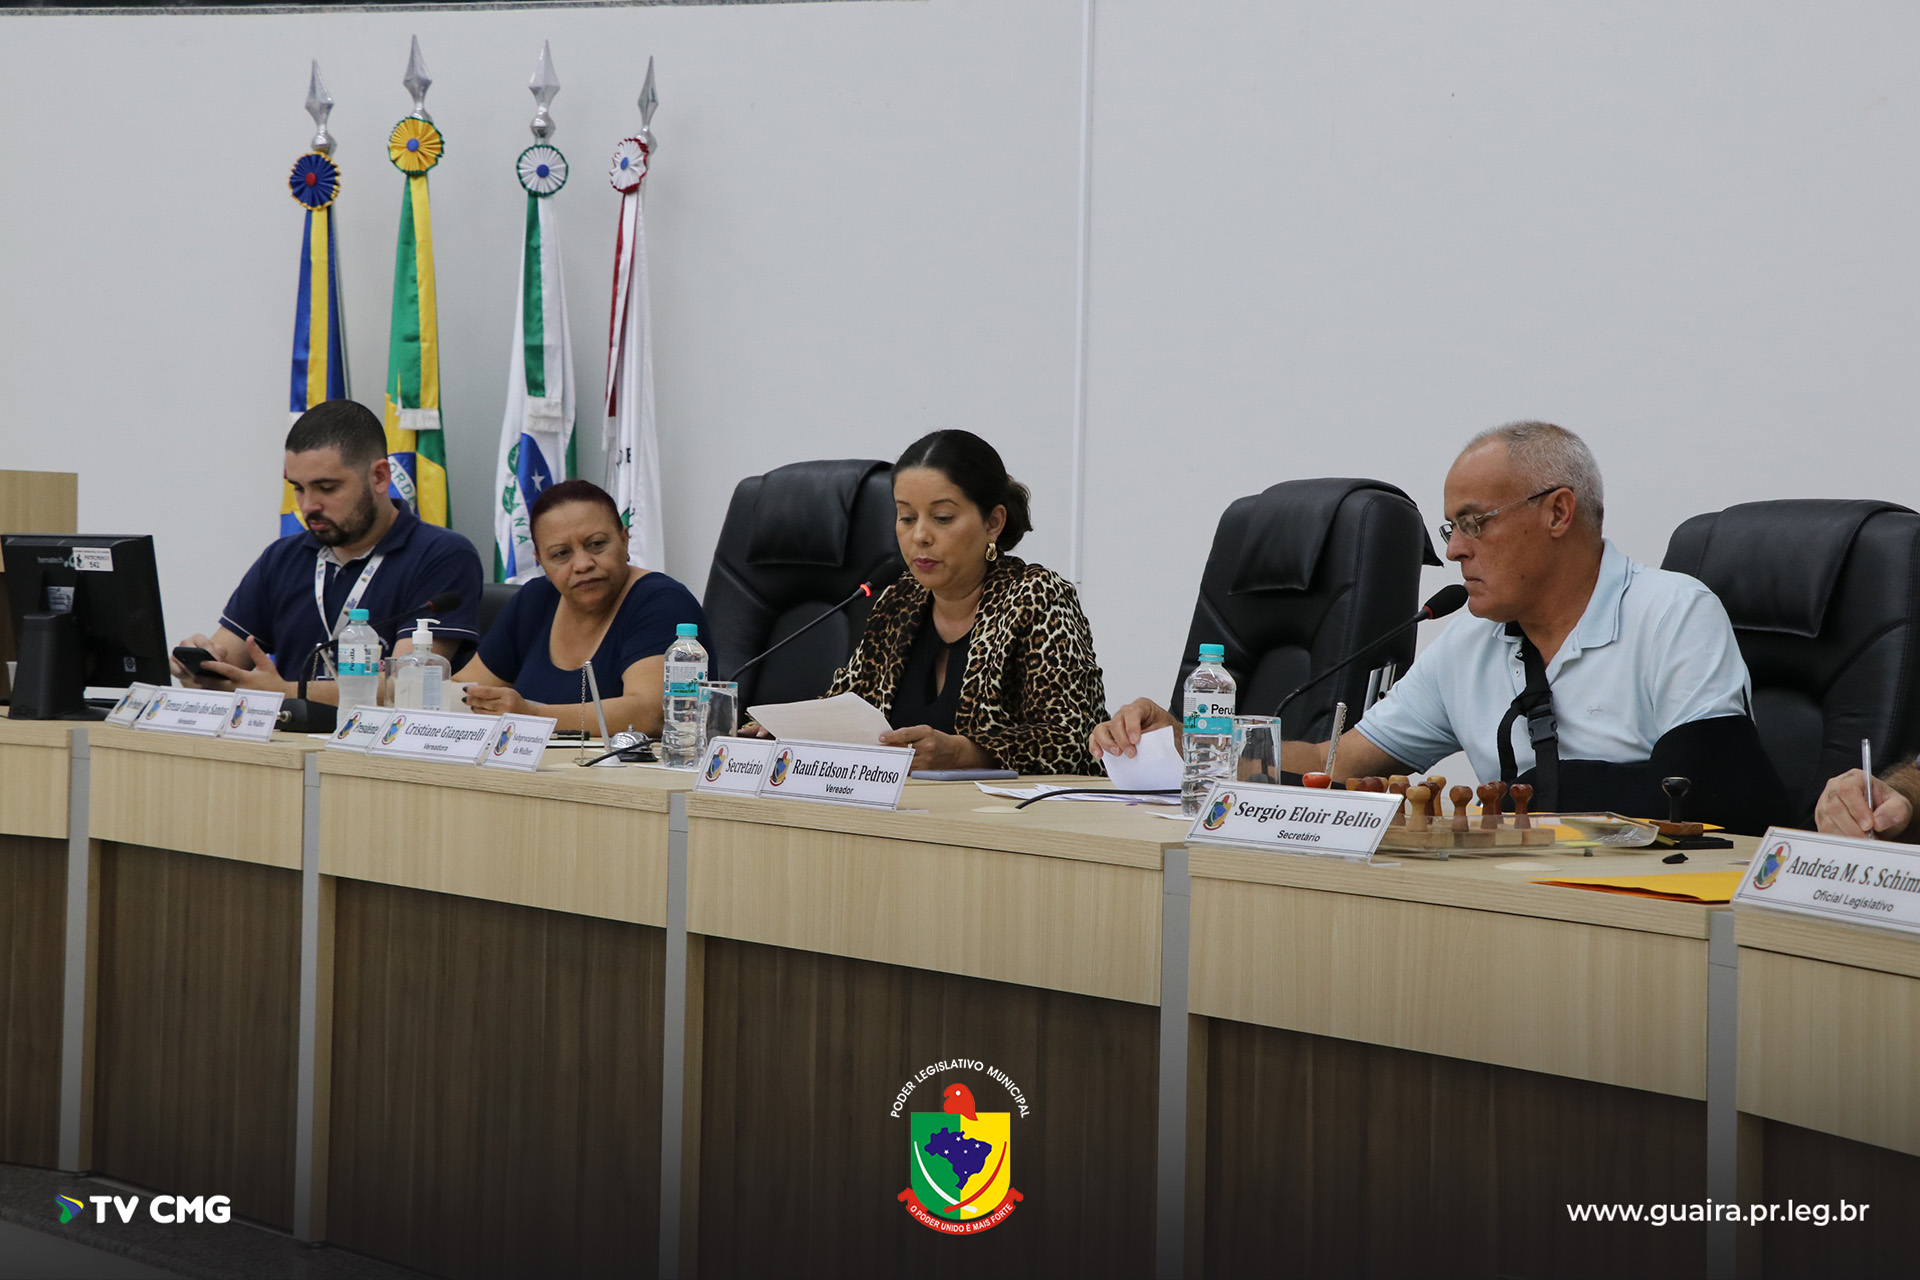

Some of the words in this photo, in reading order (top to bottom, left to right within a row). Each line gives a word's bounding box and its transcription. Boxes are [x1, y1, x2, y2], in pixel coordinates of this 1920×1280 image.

[405, 722, 441, 738] Cristiane
[440, 726, 488, 743] Giangarelli
[423, 742, 449, 752] Vereadora
[725, 757, 764, 776] Secretário
[792, 758, 819, 778] Raufi
[818, 763, 849, 781] Edson
[849, 766, 857, 781] F.
[857, 766, 900, 784] Pedroso
[825, 783, 855, 796] Vereador
[1234, 801, 1287, 824] Sergio
[1287, 805, 1331, 825] Eloir
[1331, 810, 1382, 830] Bellio
[1276, 829, 1321, 843] Secretário
[1785, 855, 1840, 882] Andréa
[1839, 862, 1859, 884] M.
[1858, 865, 1875, 886] S.
[1812, 889, 1842, 905] Oficial
[1843, 894, 1894, 913] Legislativo
